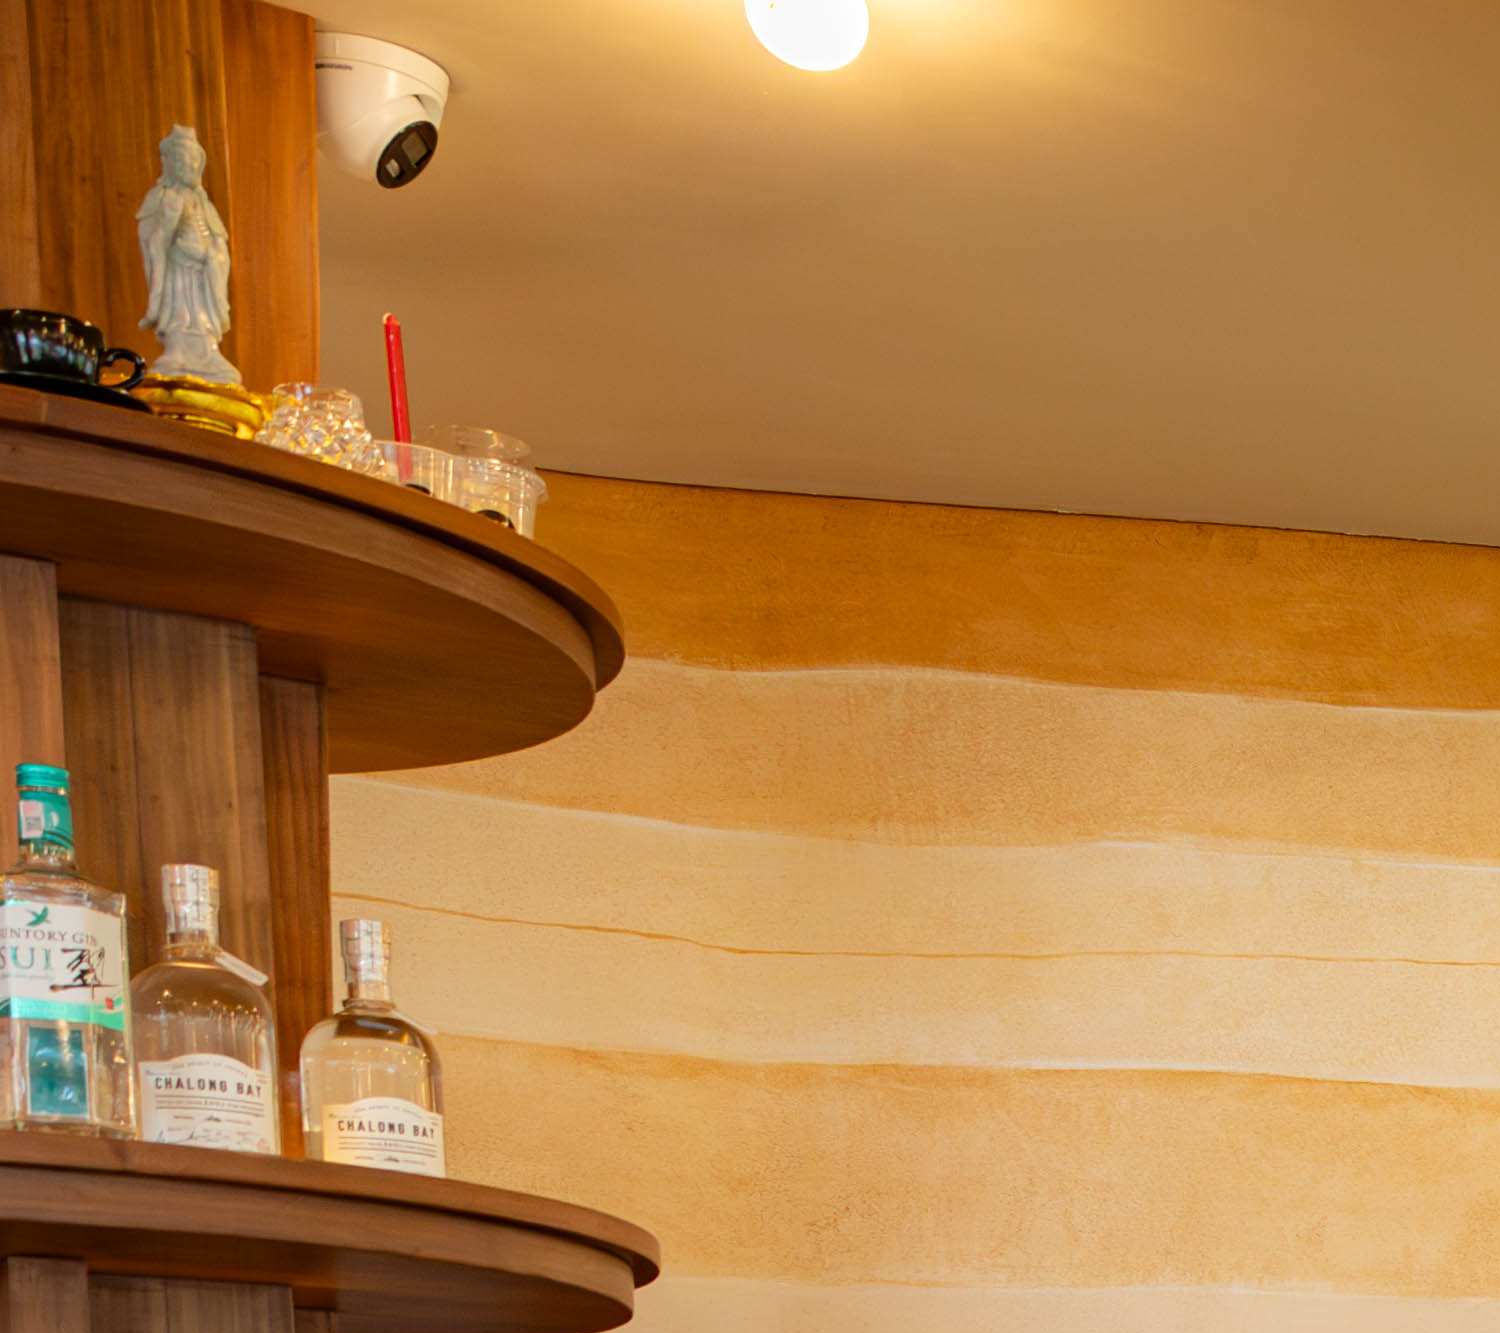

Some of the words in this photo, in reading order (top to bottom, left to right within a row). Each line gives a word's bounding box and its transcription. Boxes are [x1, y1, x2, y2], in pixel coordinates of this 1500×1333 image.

[0, 927, 66, 942] UNTORY
[155, 1076, 228, 1093] CHALONG
[236, 1081, 262, 1097] BAY
[337, 1119, 405, 1135] CHALONG
[412, 1124, 434, 1139] BAY
